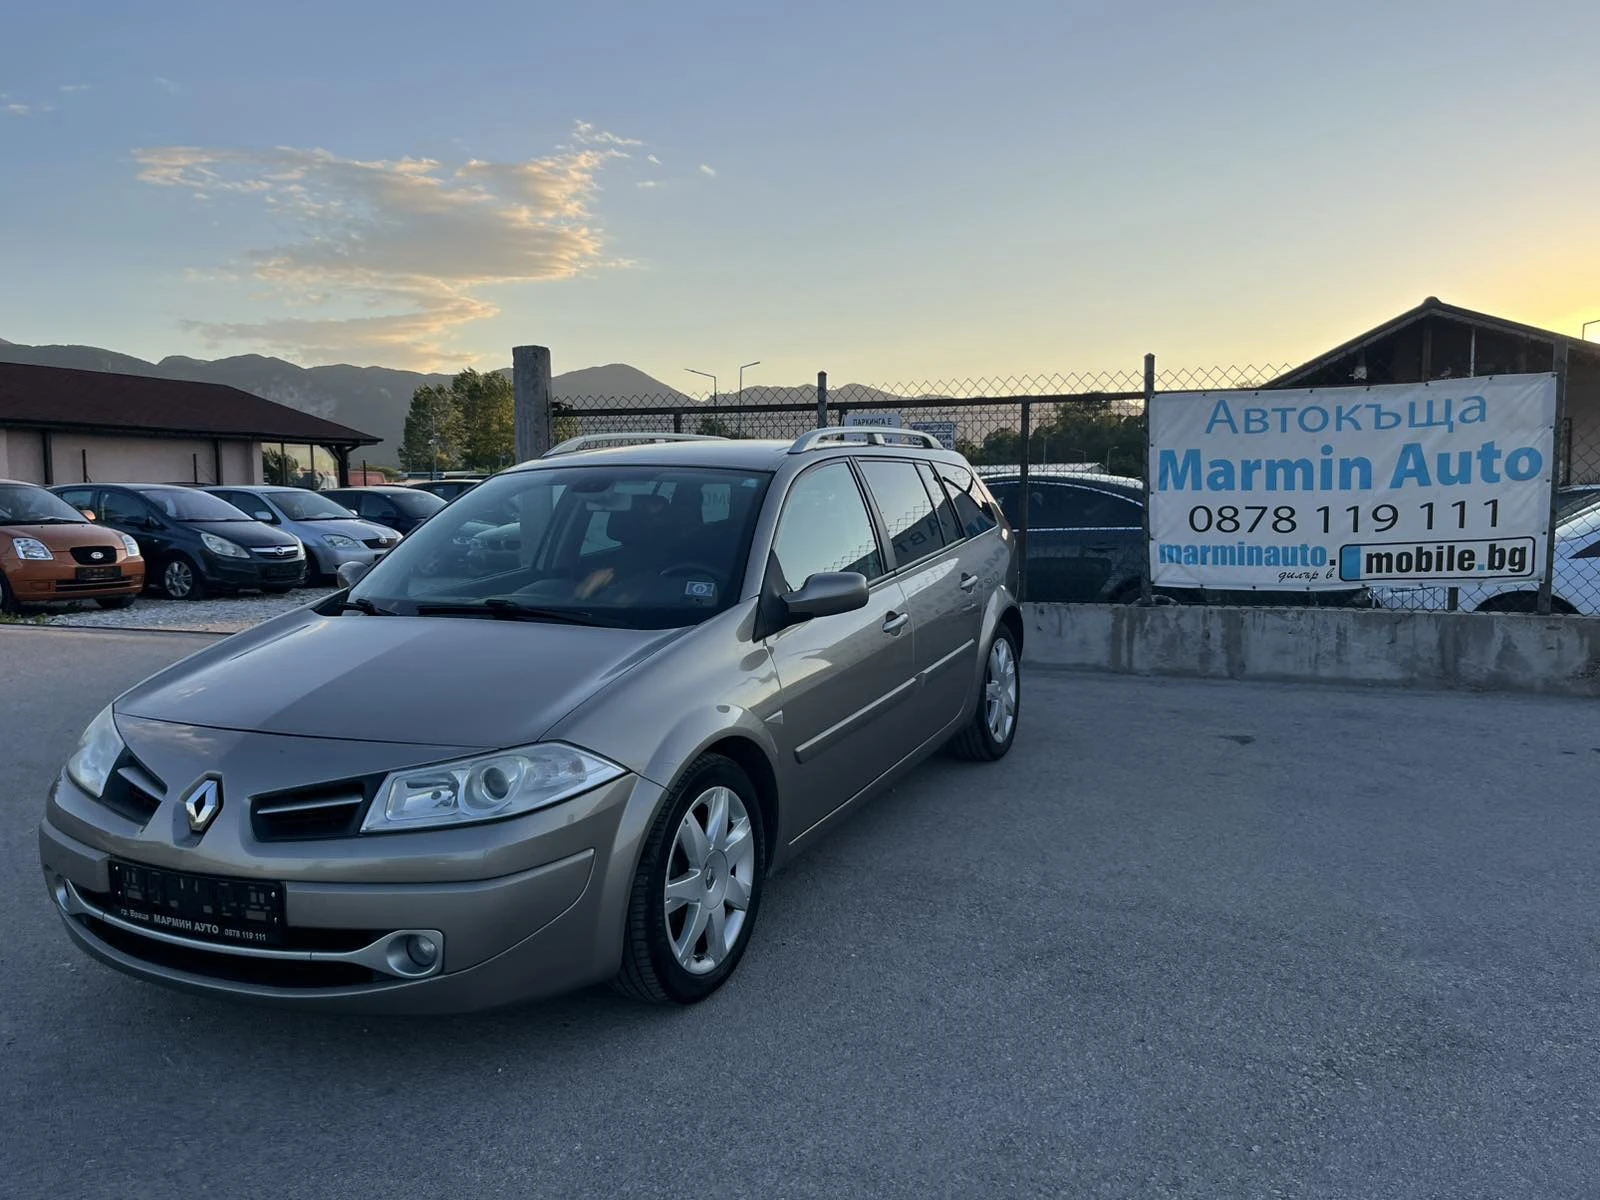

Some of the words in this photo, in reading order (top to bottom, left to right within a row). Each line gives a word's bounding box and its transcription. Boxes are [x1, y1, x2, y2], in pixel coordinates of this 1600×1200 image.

[852, 417, 885, 425] ПАРКИНГА
[1205, 395, 1487, 434] Автокъща
[1158, 444, 1372, 491] Marmin
[1389, 440, 1543, 489] Auto
[1188, 505, 1297, 533] 0878
[1316, 503, 1399, 533] 119
[1419, 498, 1498, 530] 111
[1325, 567, 1336, 579] в
[1365, 543, 1527, 574] mobile.bg
[153, 914, 192, 930] МАРМИН
[194, 921, 219, 934] АУТО
[224, 928, 240, 938] 0878
[242, 931, 254, 939] 119
[254, 933, 266, 941] 111
